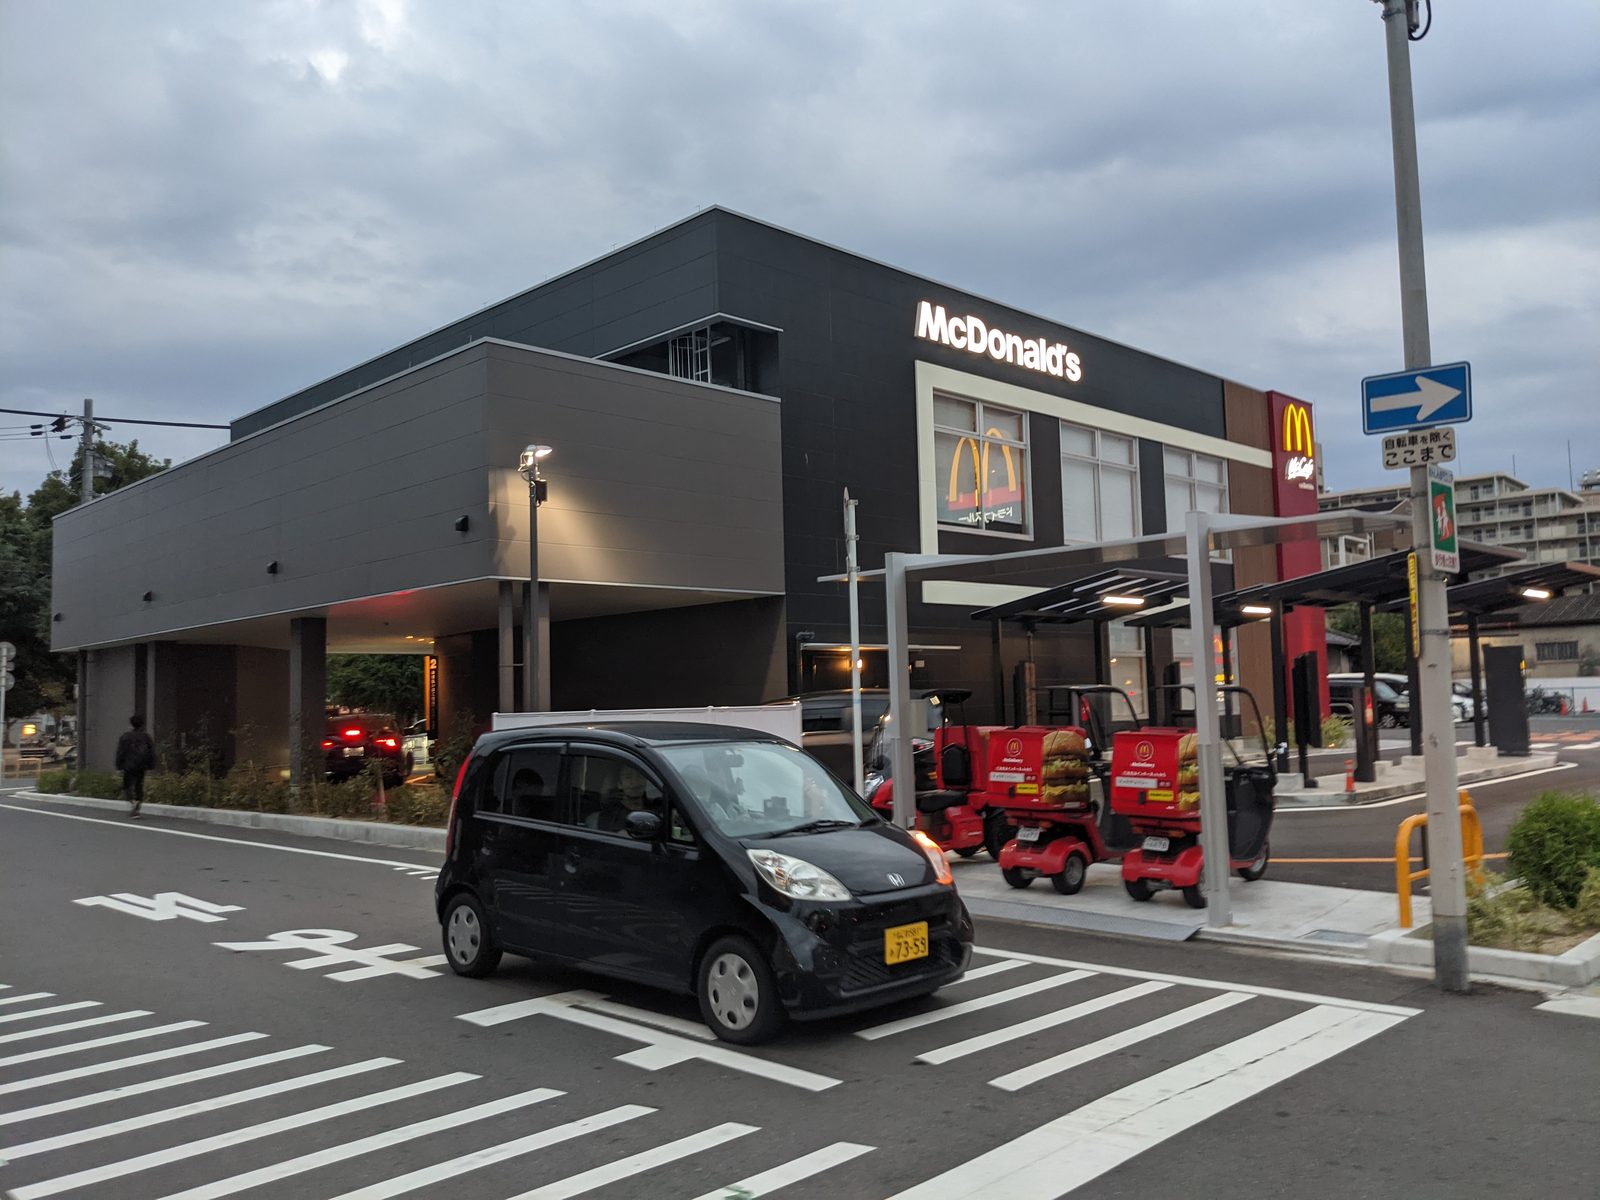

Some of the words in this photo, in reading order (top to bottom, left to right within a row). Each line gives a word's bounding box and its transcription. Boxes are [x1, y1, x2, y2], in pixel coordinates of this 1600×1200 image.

[914, 300, 1083, 383] McDonald's
[1385, 431, 1451, 450] 自転車を除く
[1386, 444, 1453, 466] ここまで
[896, 936, 927, 961] 73-59
